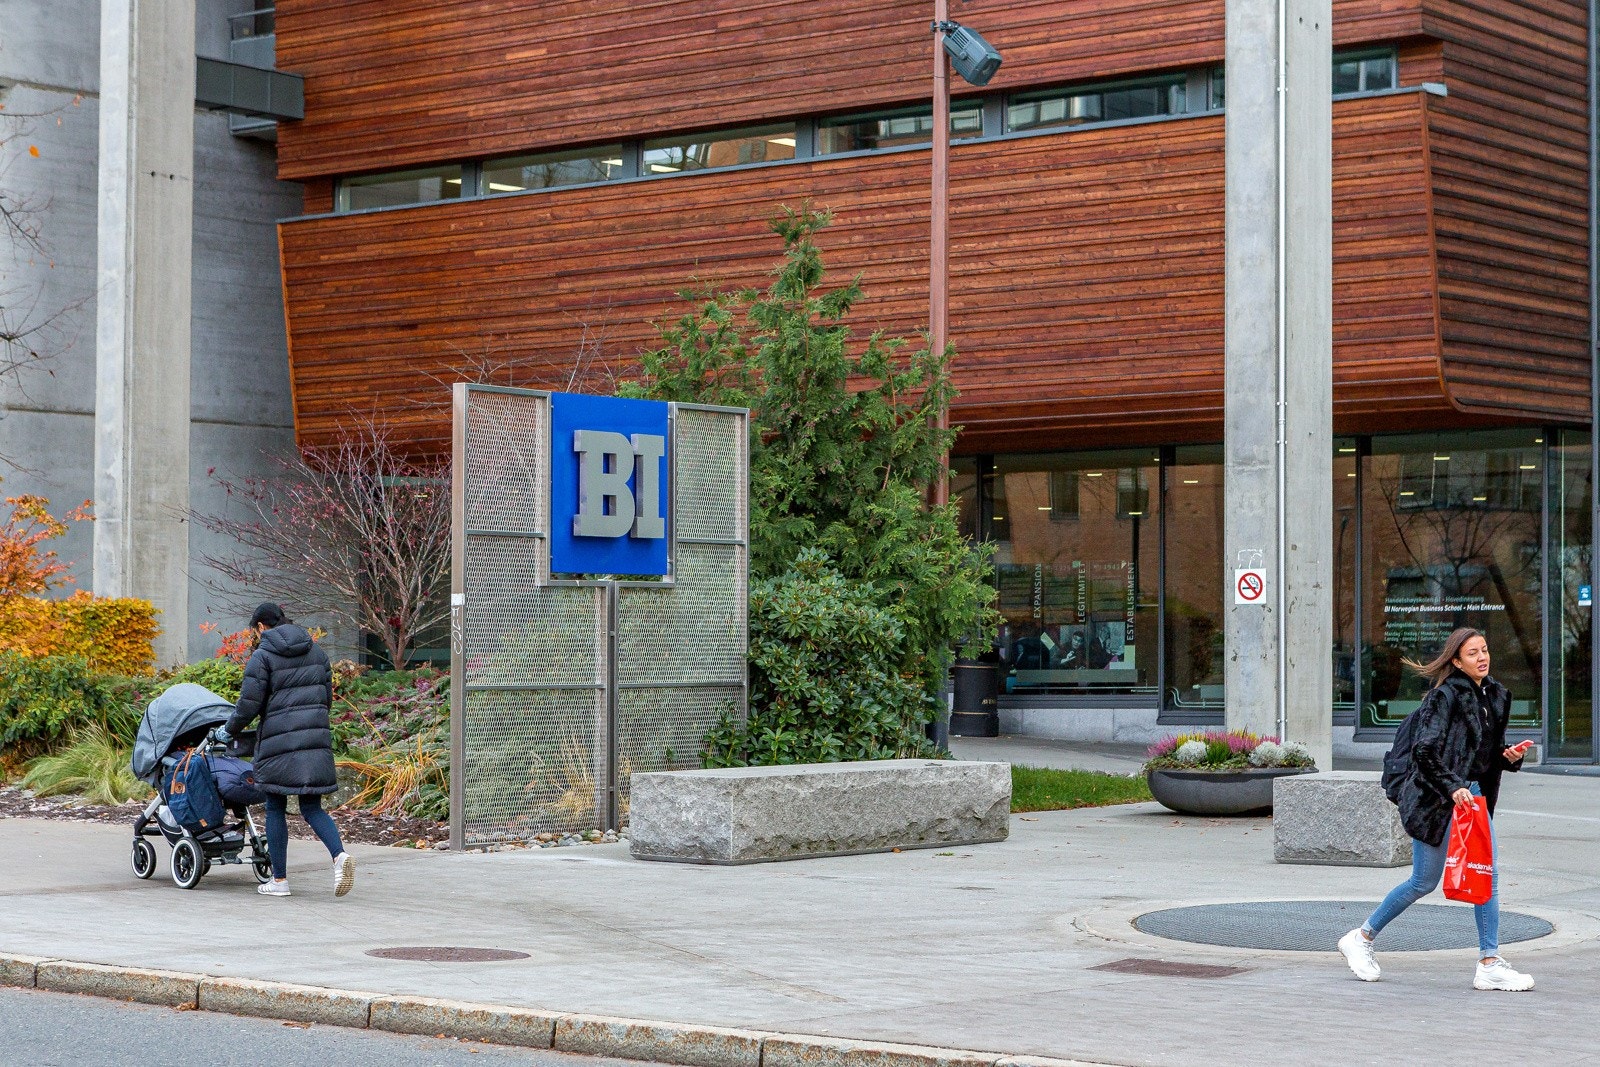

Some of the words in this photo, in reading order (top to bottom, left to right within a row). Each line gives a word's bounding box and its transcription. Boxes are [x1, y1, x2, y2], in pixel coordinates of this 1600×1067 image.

[574, 429, 664, 539] BI
[1033, 563, 1042, 618] EXPANSION
[1077, 562, 1086, 622] LEGITIMITET
[1126, 561, 1135, 640] ESTABLISHMENT
[1391, 605, 1419, 613] Norwegian
[1420, 604, 1443, 612] Business
[1467, 603, 1480, 611] Main
[1481, 603, 1505, 611] Entrance
